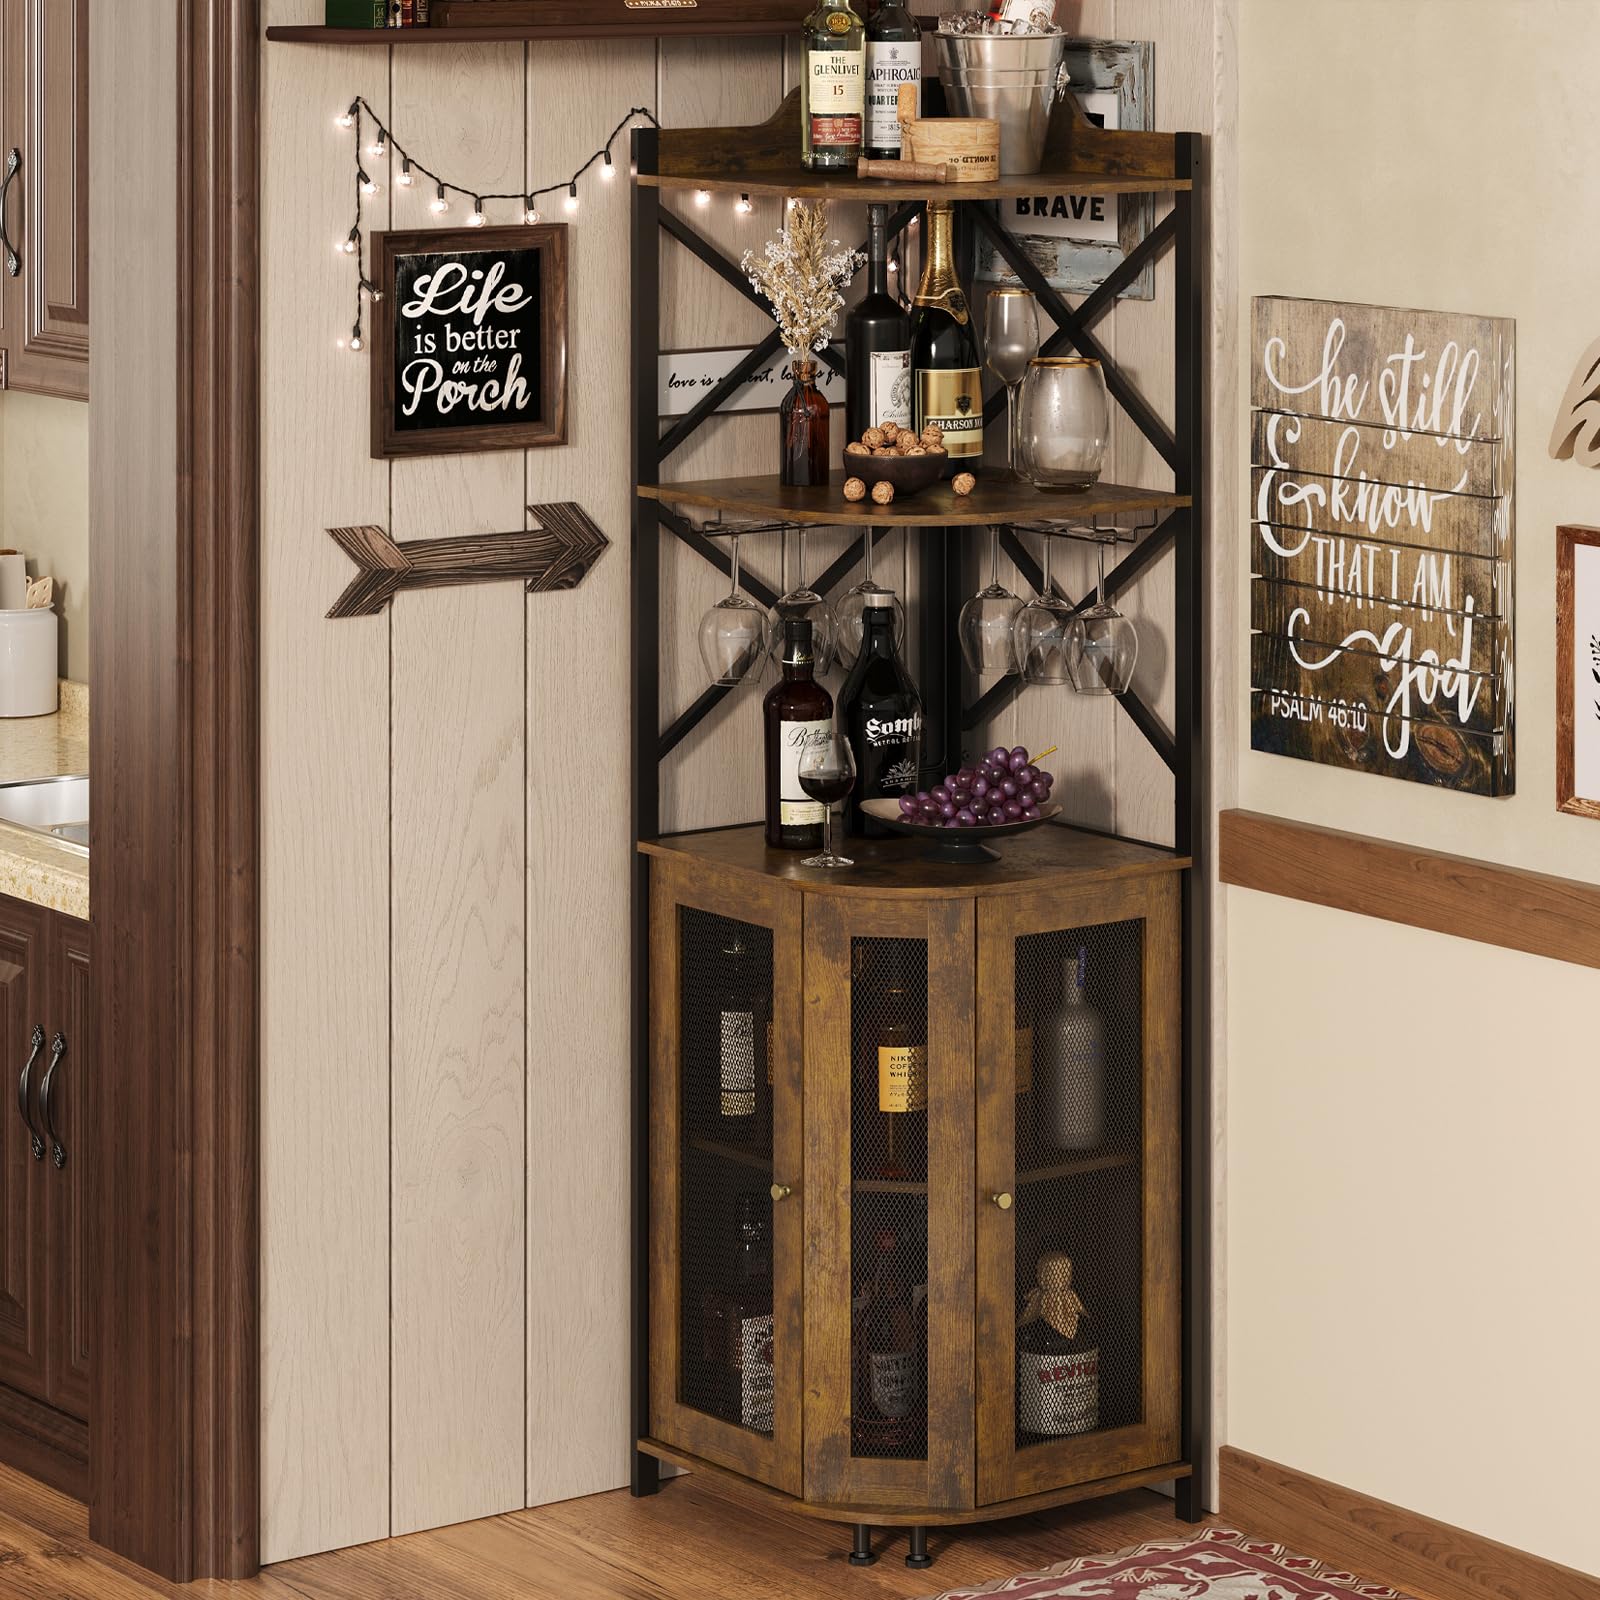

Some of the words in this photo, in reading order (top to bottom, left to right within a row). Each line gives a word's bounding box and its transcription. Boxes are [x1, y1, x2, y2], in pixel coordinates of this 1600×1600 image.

[814, 64, 860, 76] GLENLIVET
[830, 56, 846, 64] THE
[833, 84, 844, 96] 15
[1016, 195, 1105, 222] BRAVE
[402, 261, 533, 326] Life
[414, 324, 437, 354] is
[444, 322, 521, 352] better
[452, 360, 471, 374] on
[473, 354, 497, 373] the
[668, 372, 697, 388] love
[700, 374, 714, 386] is
[402, 353, 532, 416] Porch
[1264, 318, 1369, 424] be
[1379, 333, 1481, 455] still
[1331, 426, 1468, 534] know
[1311, 537, 1382, 610] THAT
[1388, 549, 1402, 611] I
[1411, 553, 1457, 637] AM
[1287, 594, 1483, 760] god
[1271, 688, 1323, 724] PSALM
[1328, 697, 1368, 732] 46:10
